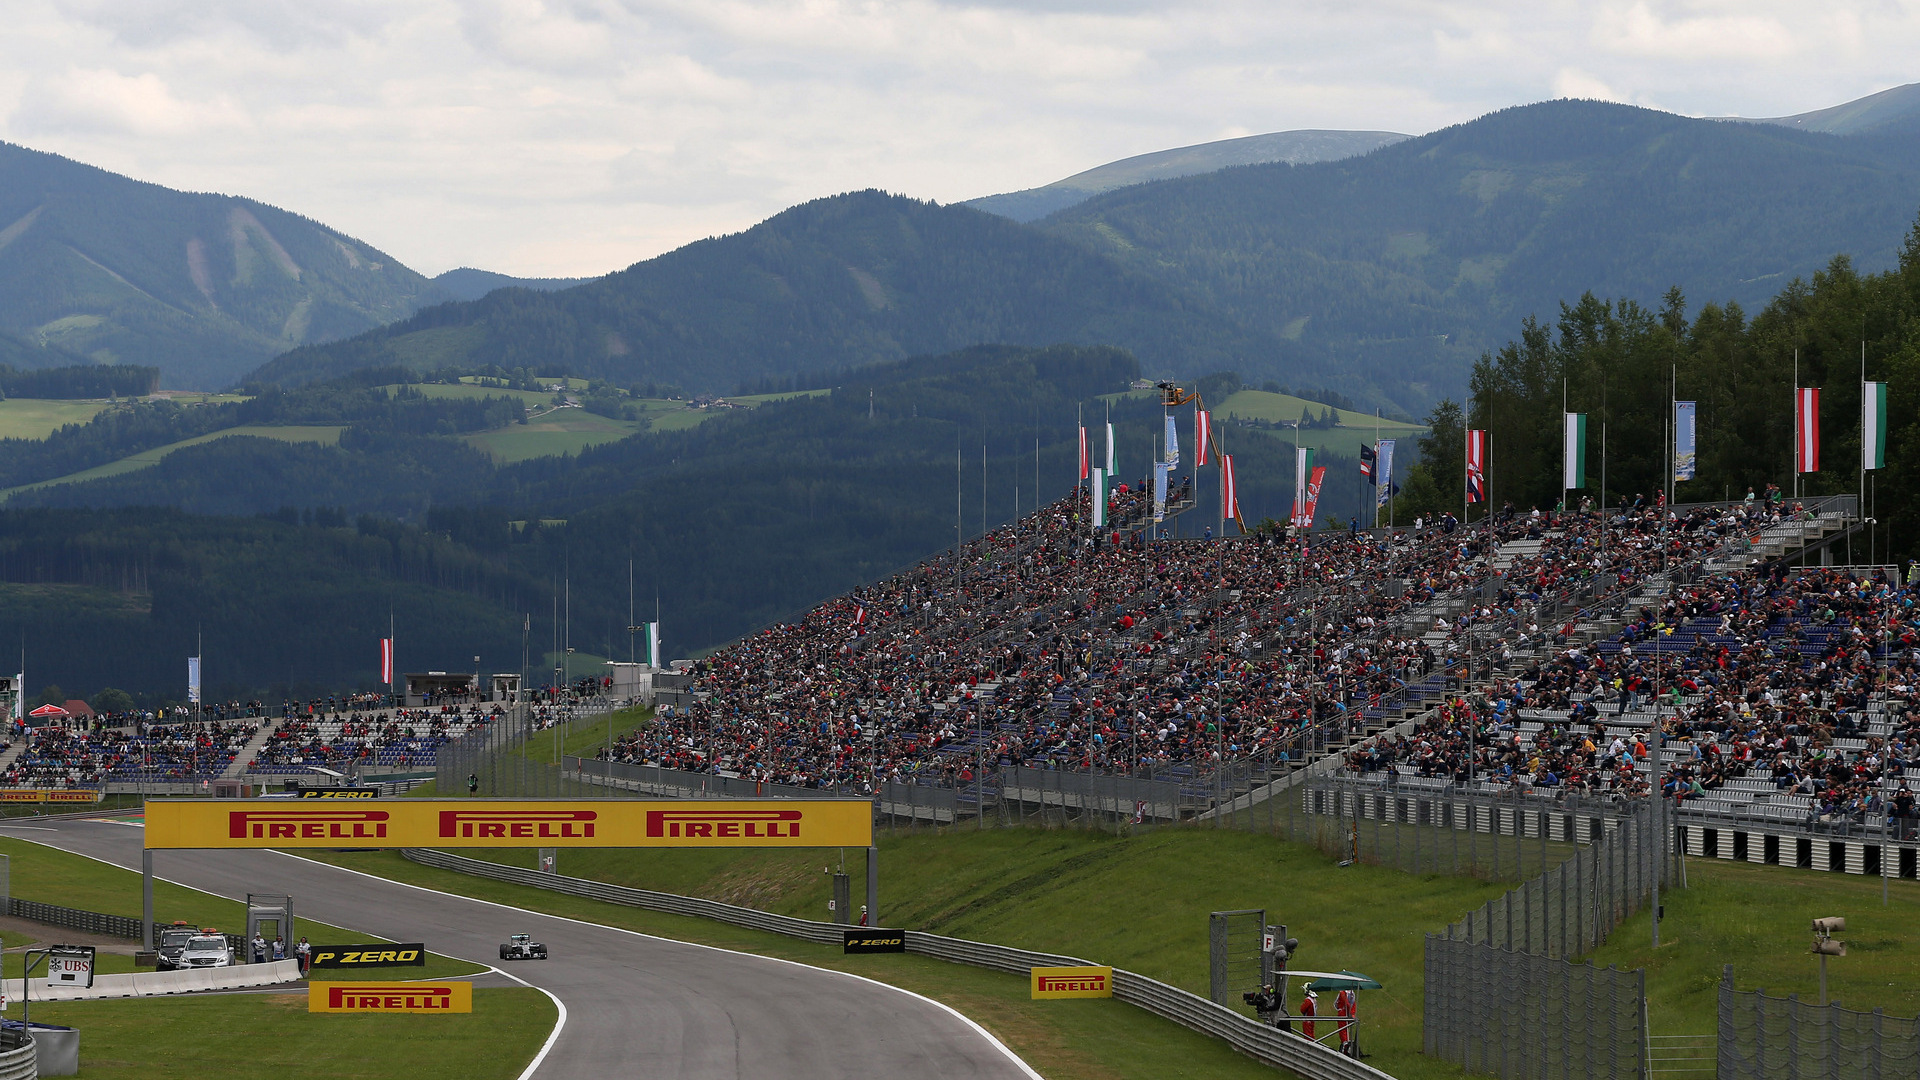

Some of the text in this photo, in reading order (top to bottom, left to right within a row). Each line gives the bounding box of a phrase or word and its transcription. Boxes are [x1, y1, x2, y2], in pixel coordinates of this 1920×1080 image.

[229, 811, 389, 839] PIRELLI
[438, 810, 597, 838] PIRELLI
[646, 810, 802, 838] PIRELLI
[1266, 938, 1272, 948] F
[64, 960, 89, 972] UBS
[314, 950, 419, 964] P ZERO
[1038, 976, 1105, 991] PIRELLI
[329, 987, 452, 1009] PIRELLI
